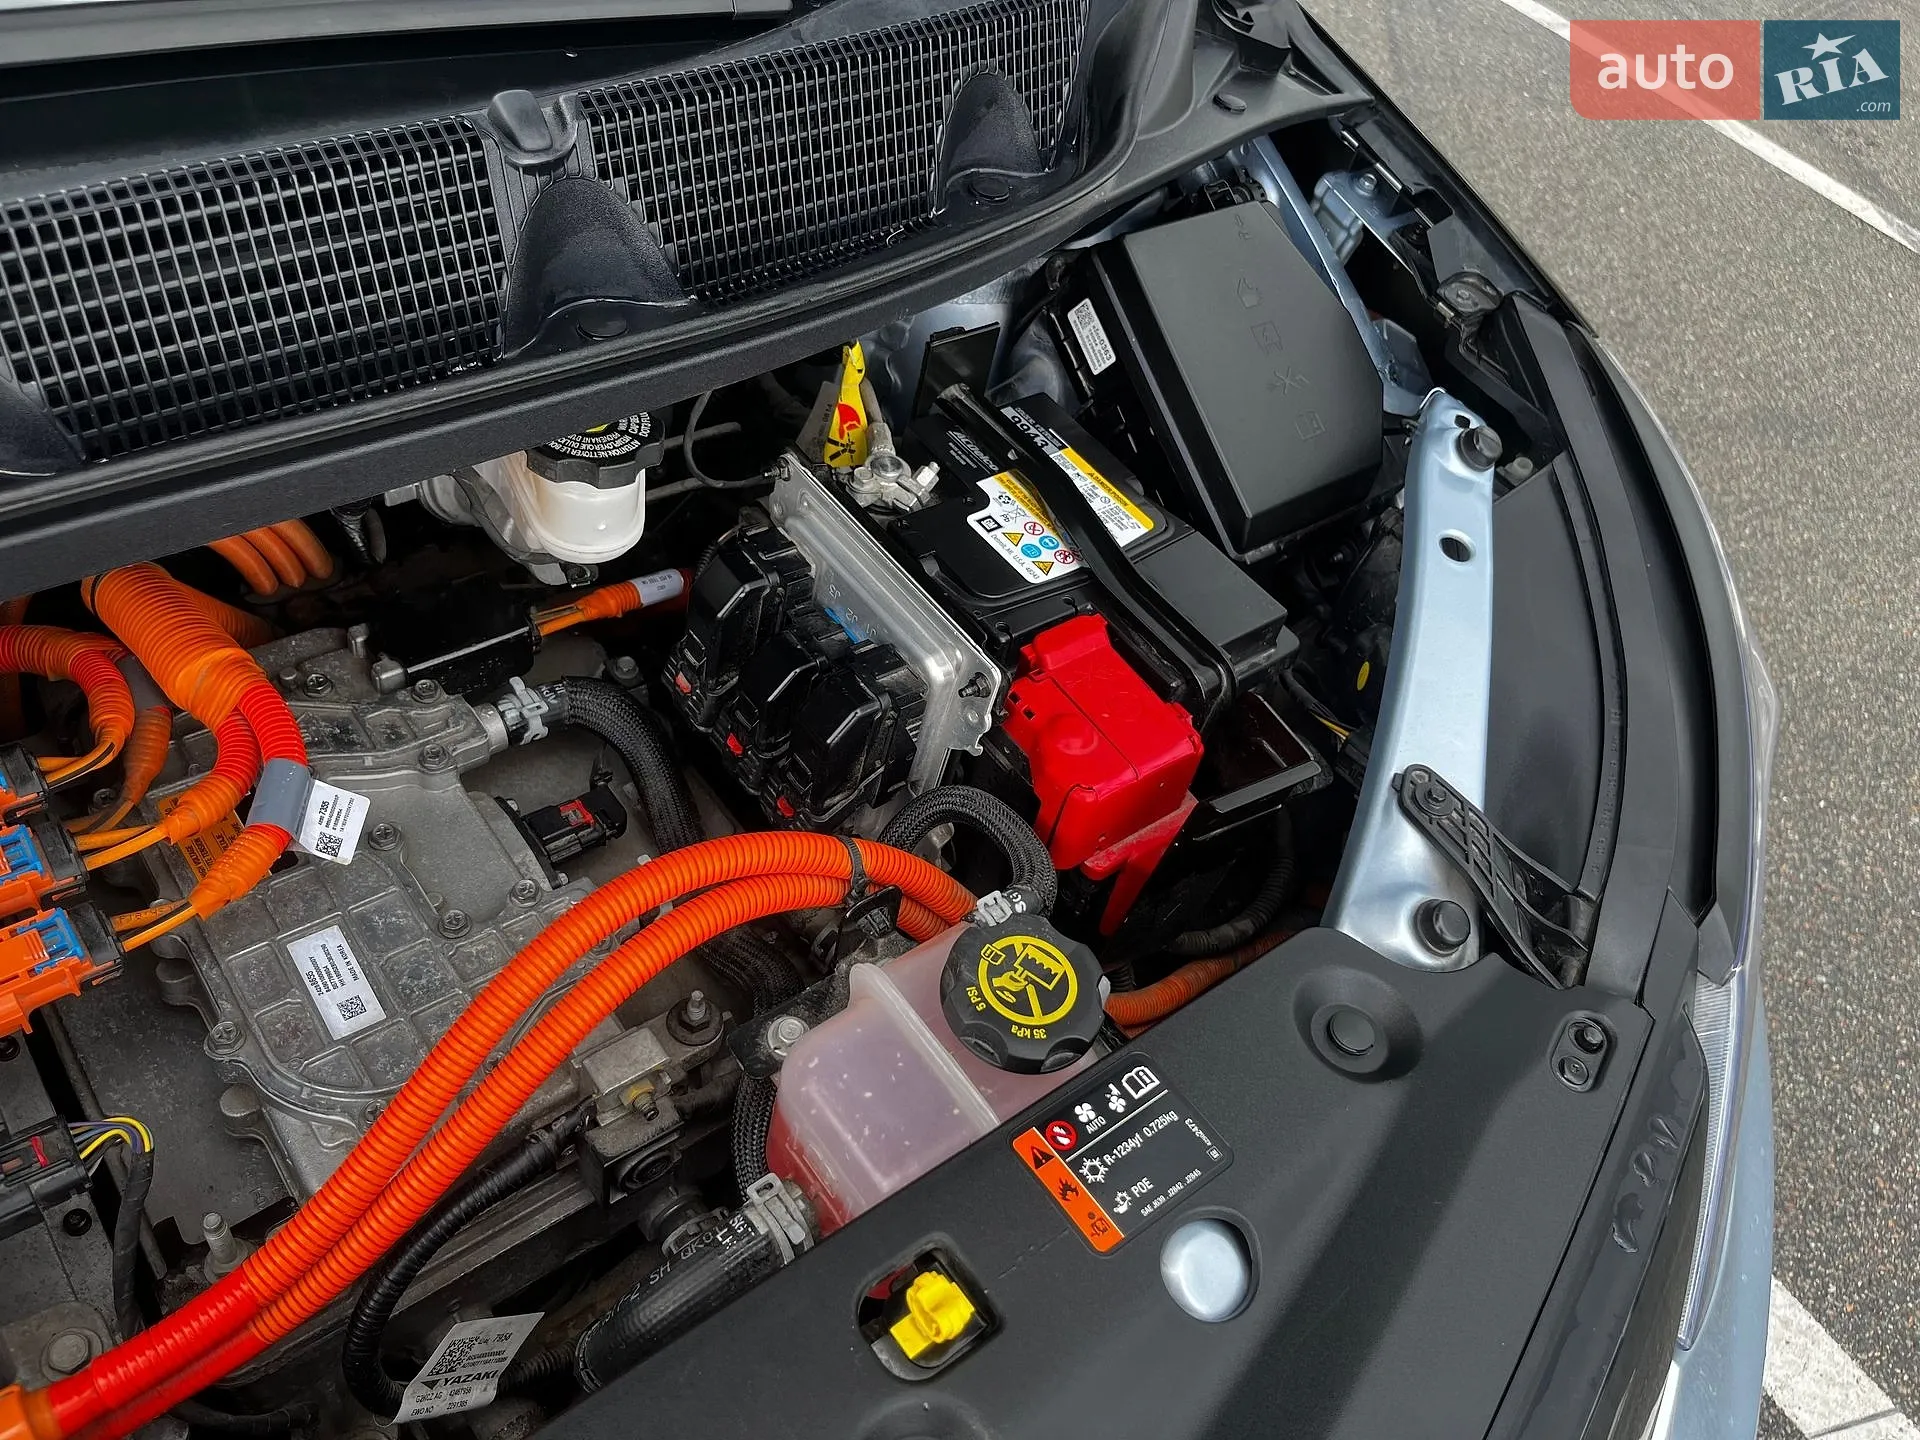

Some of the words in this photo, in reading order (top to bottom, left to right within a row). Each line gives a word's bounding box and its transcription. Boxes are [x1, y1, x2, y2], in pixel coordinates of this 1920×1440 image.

[560, 445, 571, 455] LE
[568, 440, 580, 449] DU
[579, 442, 593, 451] QUE
[571, 449, 608, 458] NETTOYER
[337, 944, 350, 962] KOREA
[350, 967, 360, 982] MADE
[966, 986, 983, 1004] PSI
[976, 1001, 987, 1012] 5
[1011, 1024, 1031, 1039] kPa
[1033, 1028, 1047, 1039] 35
[1085, 1116, 1107, 1135] AUTO
[1103, 1134, 1143, 1166] R-1234yf
[1143, 1110, 1180, 1138] 0.725kg
[1131, 1177, 1155, 1198] POE
[444, 1370, 498, 1387] YAZAKI
